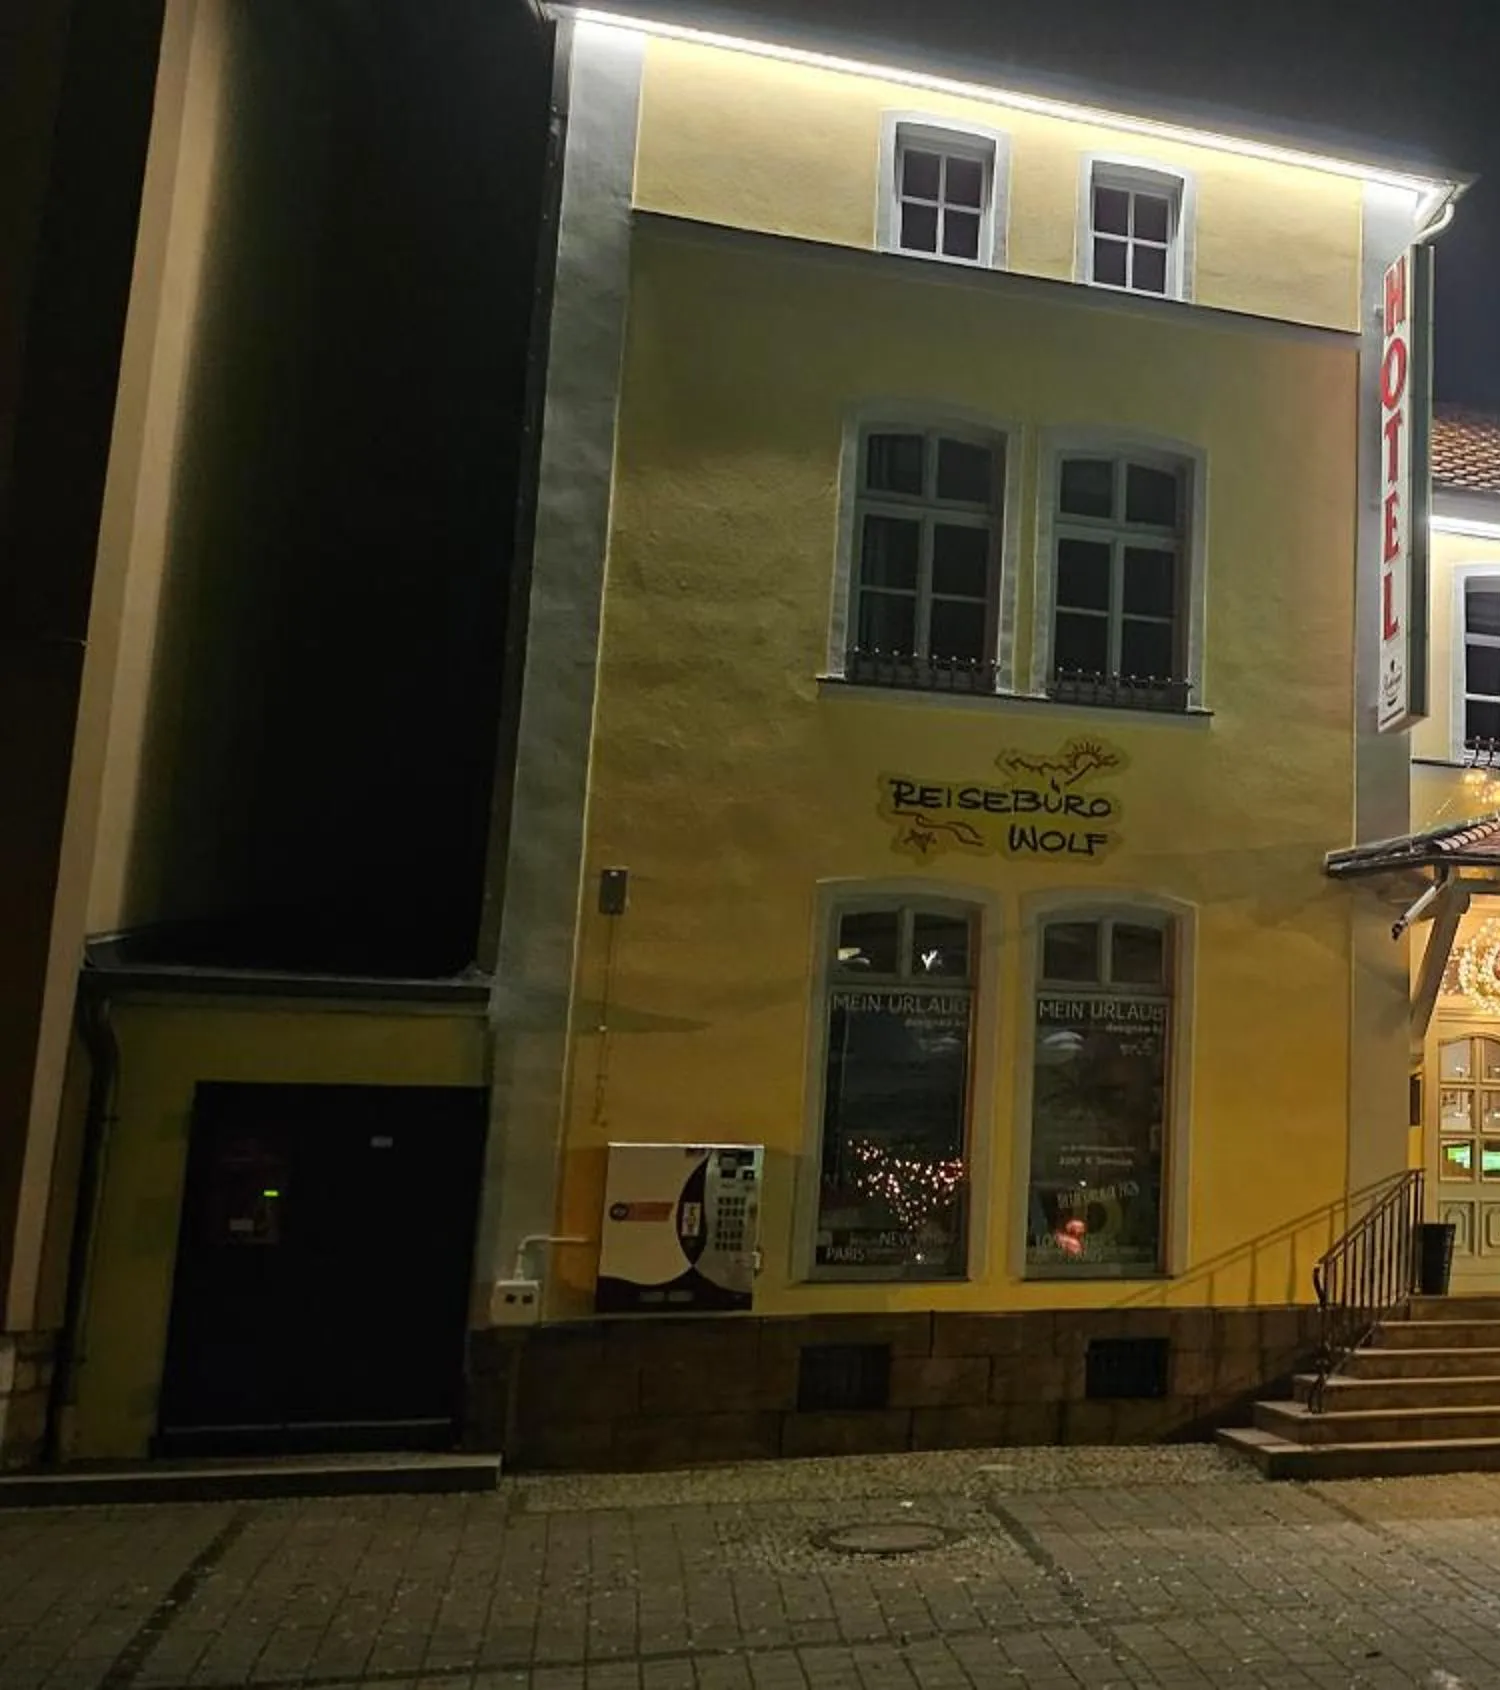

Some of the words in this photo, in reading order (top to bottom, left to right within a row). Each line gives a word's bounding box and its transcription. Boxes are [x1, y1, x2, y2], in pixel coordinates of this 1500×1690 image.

[1379, 255, 1407, 642] HOTEL
[888, 776, 1112, 818] REISEBÜRO
[1008, 823, 1109, 856] WOLF
[832, 994, 881, 1012] MEIN
[888, 994, 967, 1015] URLAUB
[1039, 1000, 1084, 1020] MEIN
[1090, 1001, 1165, 1022] URLAUB
